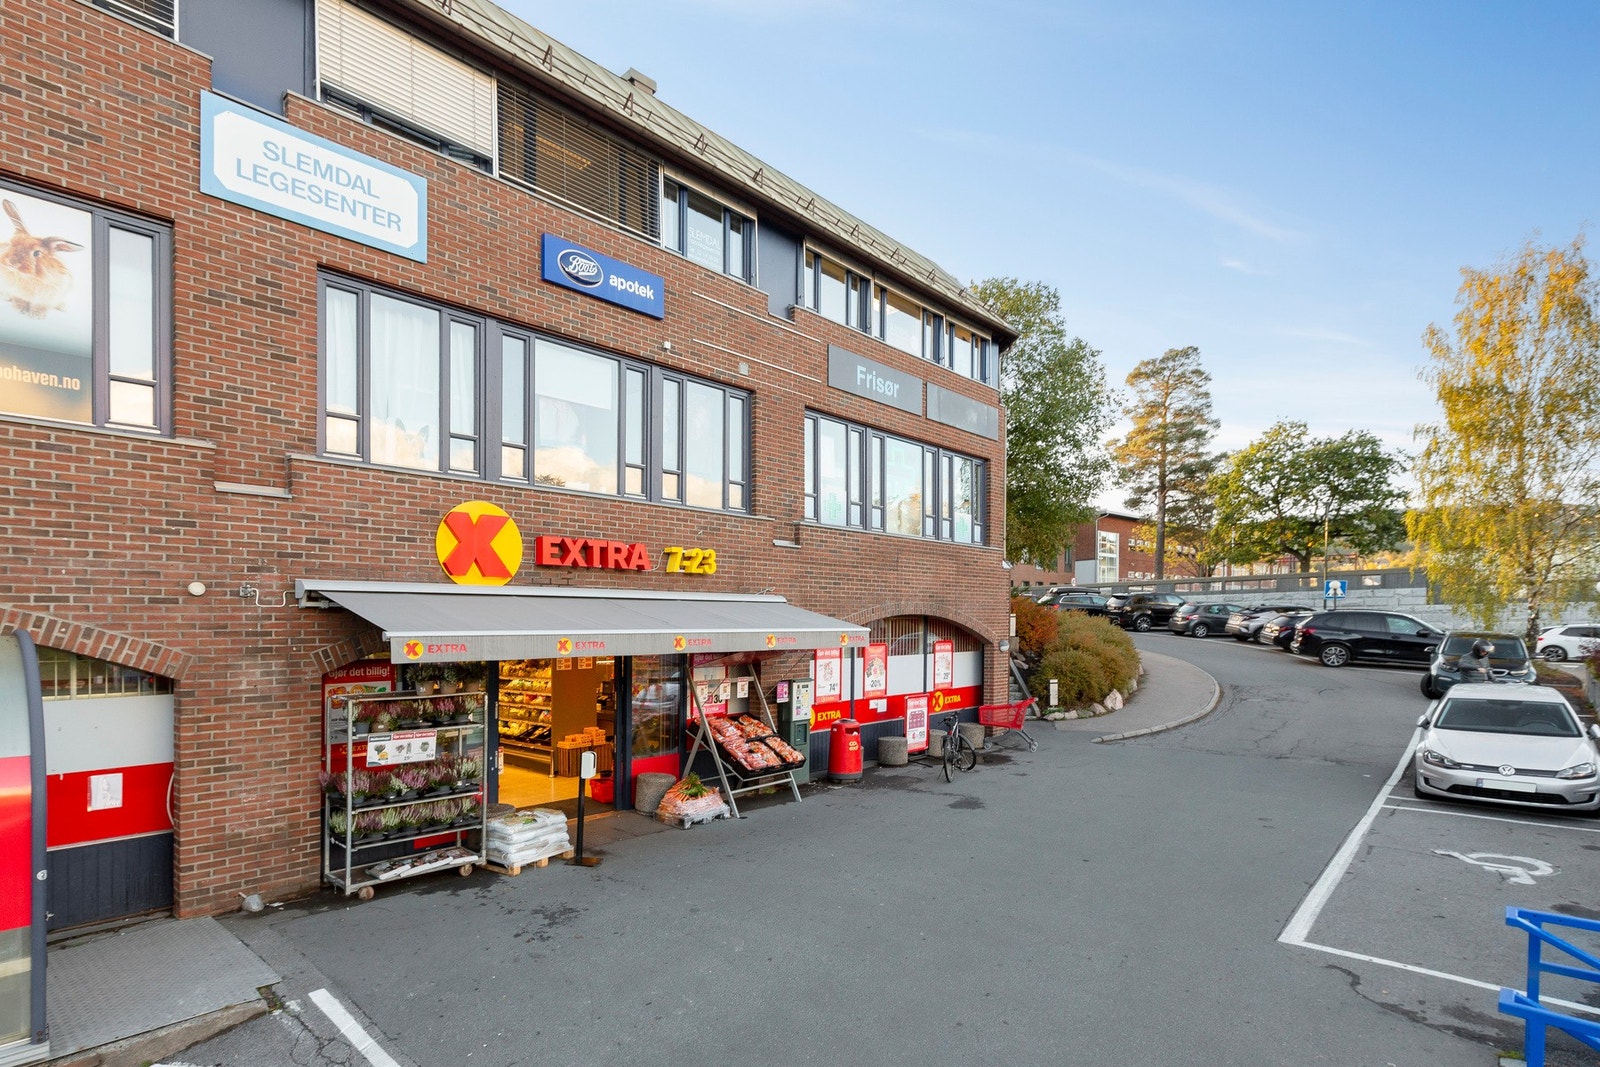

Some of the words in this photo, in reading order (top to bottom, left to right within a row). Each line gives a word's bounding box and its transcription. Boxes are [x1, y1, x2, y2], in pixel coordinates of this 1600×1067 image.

[262, 140, 380, 200] SLEMDAL
[236, 157, 402, 232] LEGESENTER
[564, 254, 599, 276] Boots
[609, 274, 655, 300] apotek
[856, 365, 900, 398] Frisør
[535, 535, 652, 571] EXTRA
[664, 546, 717, 575] 7-23
[574, 640, 606, 650] EXTRA
[688, 637, 712, 647] EXTRA
[777, 637, 797, 645] EXTRA
[427, 643, 468, 654] EXTRA
[349, 667, 365, 677] det
[366, 665, 391, 678] billig!
[945, 694, 962, 704] EXTRA
[817, 710, 842, 721] EXTRA
